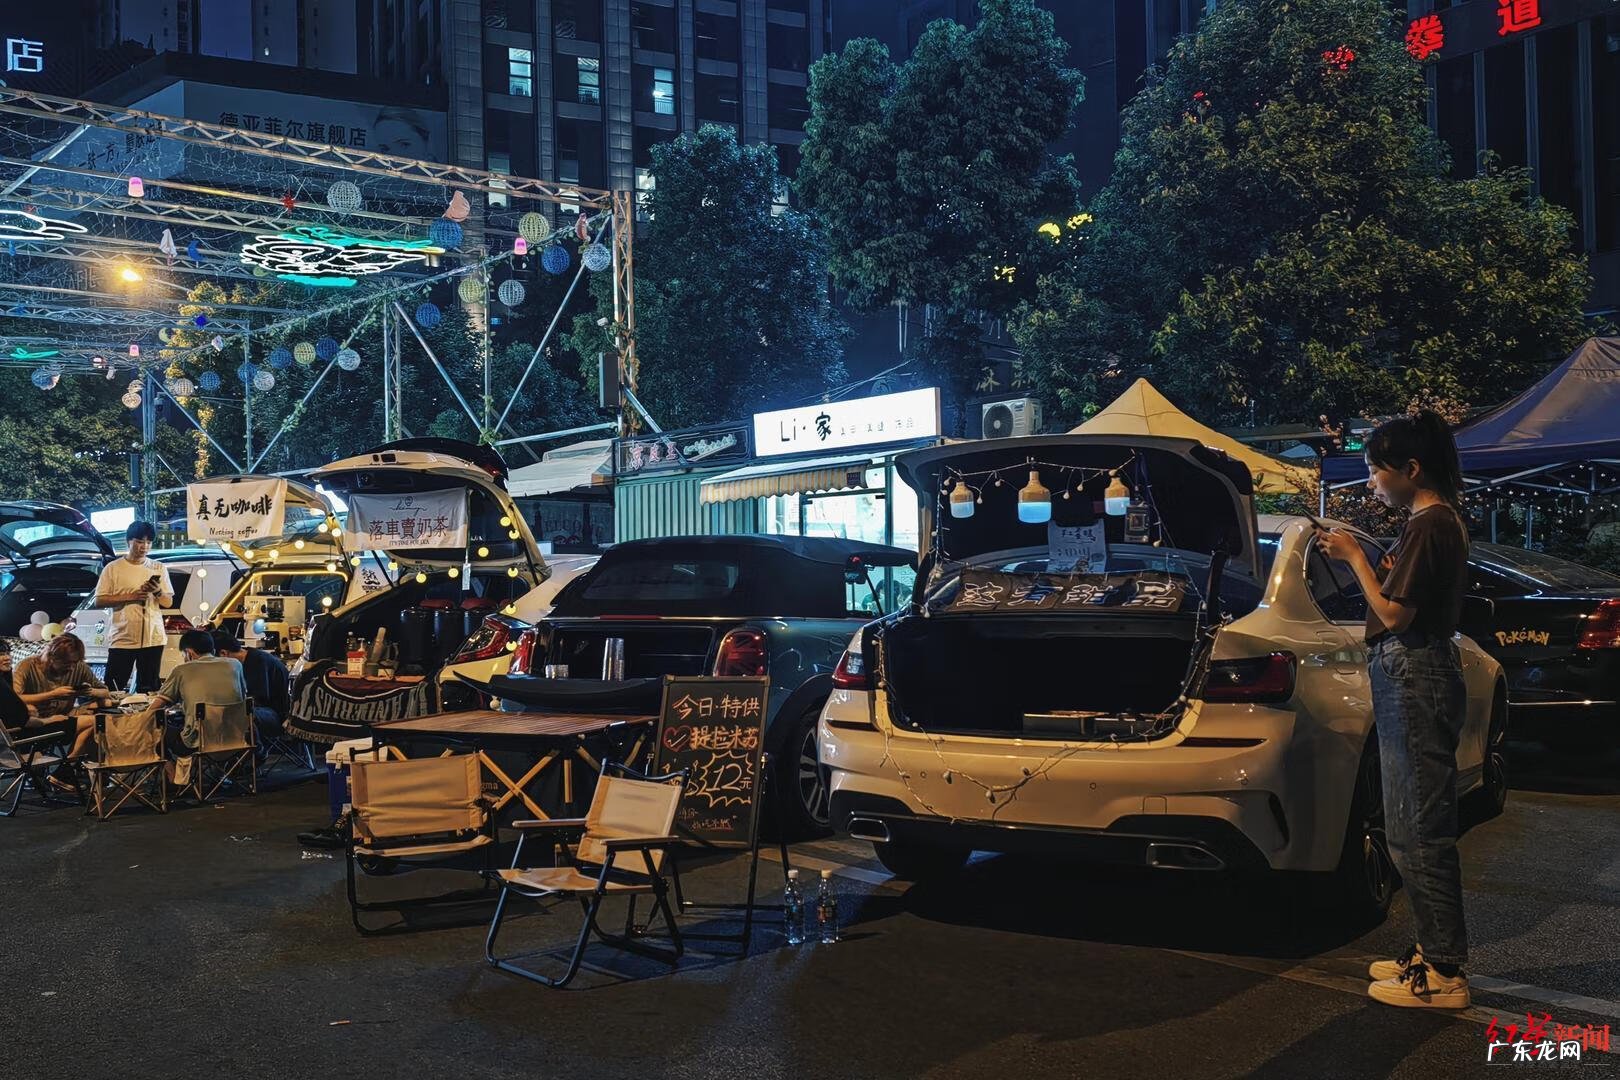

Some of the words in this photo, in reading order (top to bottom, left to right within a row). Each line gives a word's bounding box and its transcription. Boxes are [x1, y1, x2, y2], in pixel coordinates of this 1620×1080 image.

[7, 38, 44, 72] 店
[219, 111, 367, 147] 德亚菲尔旗舰店
[209, 527, 234, 539] Nothing
[369, 516, 449, 541] 落車賣奶茶
